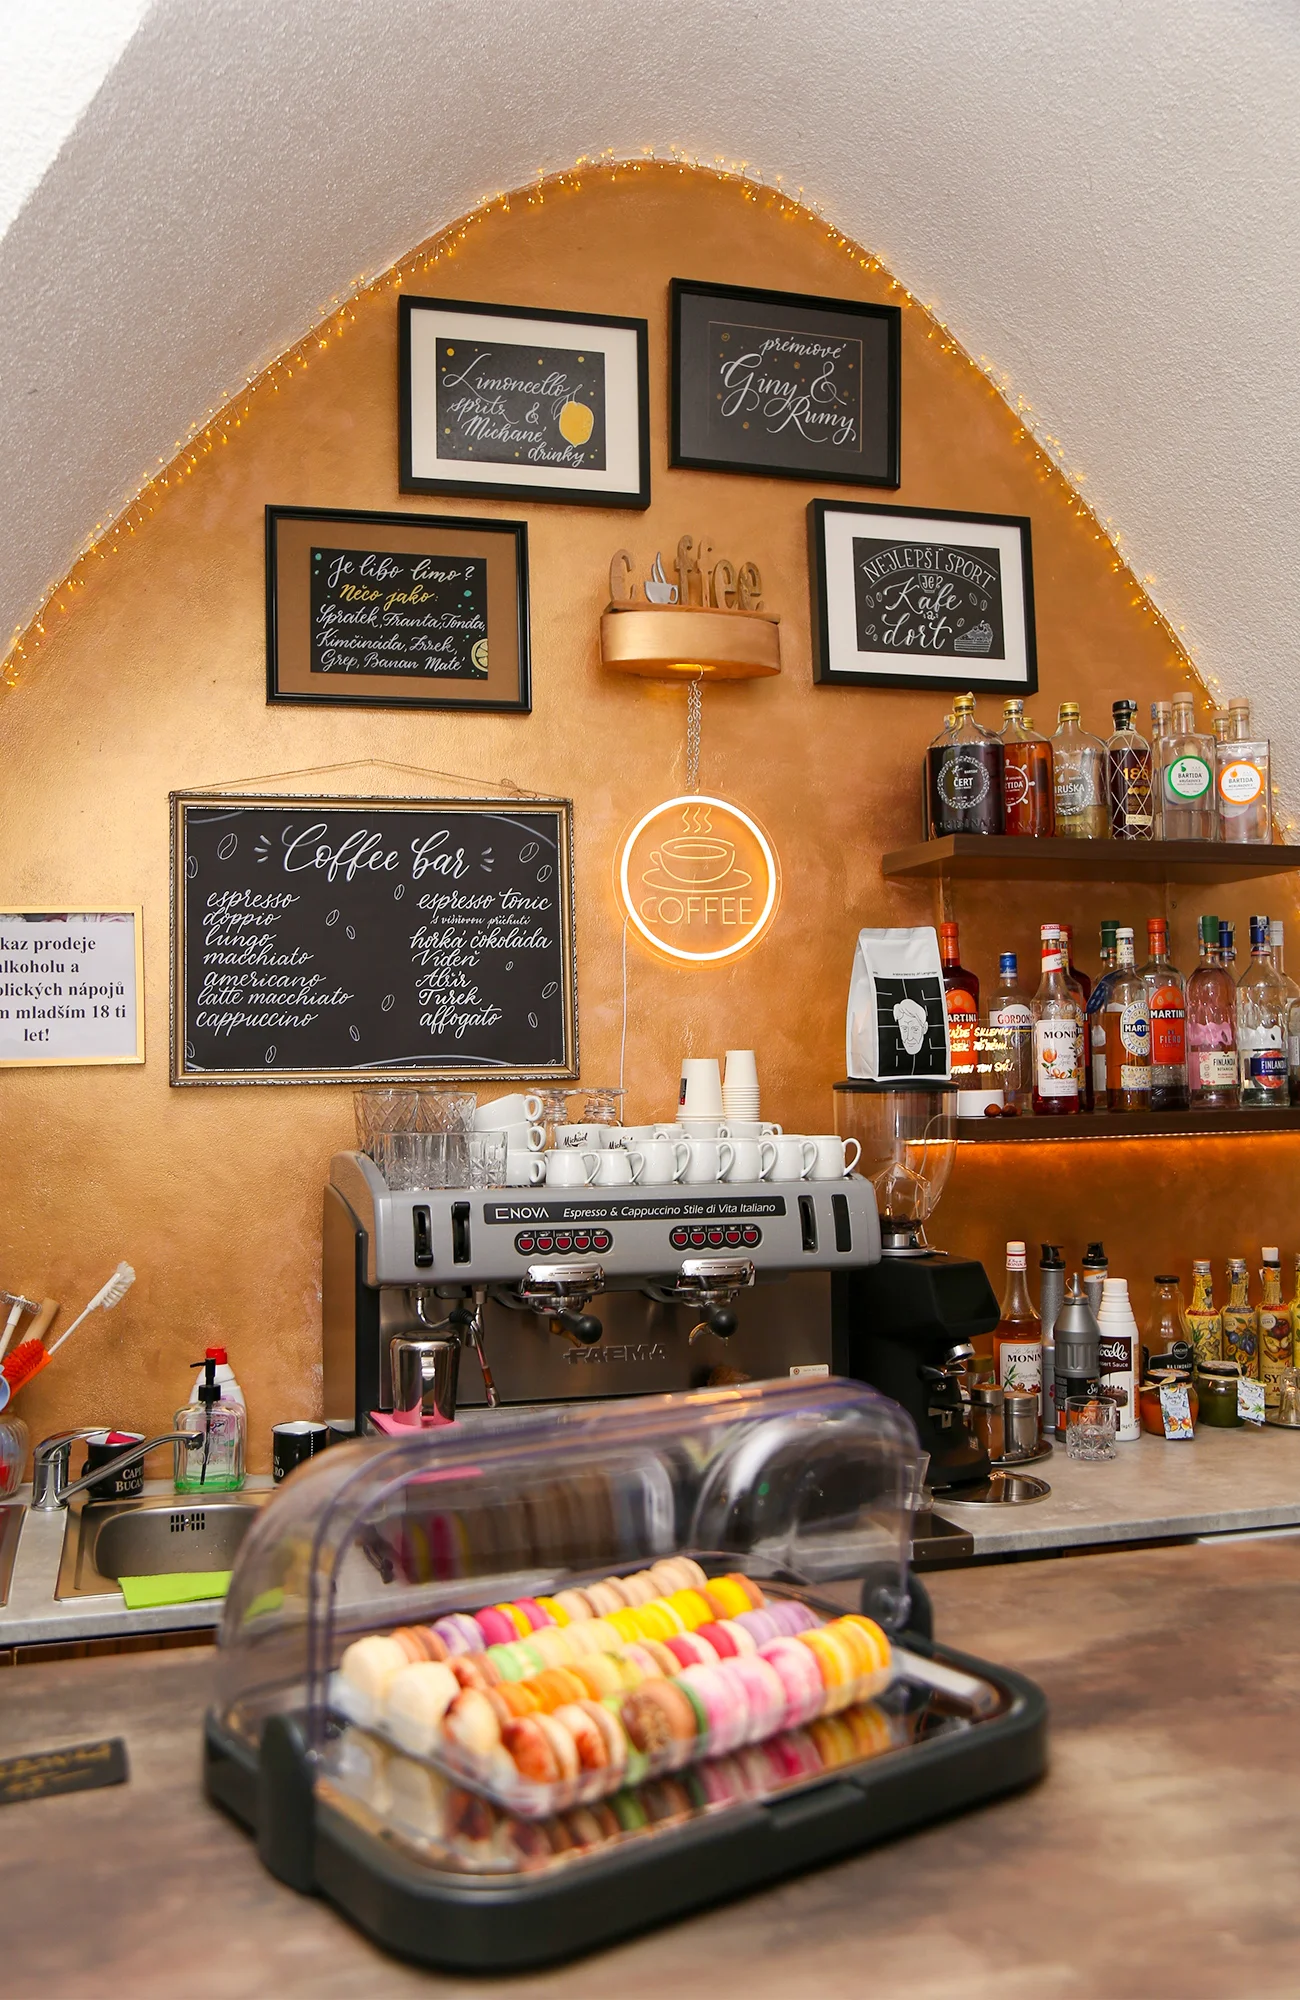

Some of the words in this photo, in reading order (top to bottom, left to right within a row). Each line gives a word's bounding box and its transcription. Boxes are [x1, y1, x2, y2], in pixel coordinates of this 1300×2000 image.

[759, 336, 847, 359] prémiové
[443, 353, 571, 404] Limoncello
[720, 353, 798, 417] Giny
[810, 361, 847, 405] &
[525, 402, 539, 425] &
[766, 395, 857, 444] Rumy
[461, 415, 547, 443] Michané
[528, 441, 584, 467] drinky
[327, 555, 354, 588] Je
[359, 554, 404, 581] libo
[411, 558, 461, 582] limo
[609, 534, 764, 610] Cffee
[945, 552, 996, 589] SPORT
[339, 584, 383, 602] Něco
[881, 613, 952, 650] dort
[953, 776, 974, 787] ČERT
[1004, 780, 1024, 790] TIDA
[1055, 783, 1085, 794] RUŠKA
[282, 823, 400, 882] Coffee
[411, 830, 470, 879] bar
[206, 889, 301, 912] espresso
[416, 889, 496, 919] espresso
[498, 887, 552, 911] tonic
[640, 896, 754, 925] COFFEE
[202, 906, 281, 933] doppio
[0, 937, 29, 951] kaz
[33, 936, 97, 954] prodeje
[204, 924, 277, 956] lungo
[409, 925, 467, 949] horká
[469, 926, 553, 949] čokoláda
[203, 943, 314, 966] macchiato
[411, 949, 480, 967] Vídeň
[70, 963, 80, 974] a
[203, 970, 327, 988] americano
[415, 967, 471, 988] Alžír
[68, 980, 125, 1000] nápojů
[196, 986, 244, 1006] latte
[247, 985, 355, 1006] macchiato
[418, 986, 483, 1006] Turek
[15, 1004, 86, 1019] mladším
[92, 1004, 110, 1019] 18
[115, 1004, 127, 1019] ti
[419, 1004, 502, 1039] affogato
[948, 1013, 976, 1023] ARTINI
[1150, 1009, 1185, 1018] MARTINI
[23, 1027, 50, 1042] let!
[196, 1010, 319, 1037] cappuccino
[949, 1023, 974, 1039] AŽDÉ
[950, 1042, 970, 1052] SEK
[1261, 1060, 1287, 1070] FINLAND
[563, 1206, 608, 1219] Espresso
[610, 1207, 618, 1217] &
[621, 1204, 681, 1220] Cappuccino
[683, 1203, 704, 1215] Stile
[706, 1204, 716, 1214] di
[717, 1202, 738, 1214] Vita
[740, 1201, 776, 1213] Italiano
[562, 1343, 666, 1365] FAEMA
